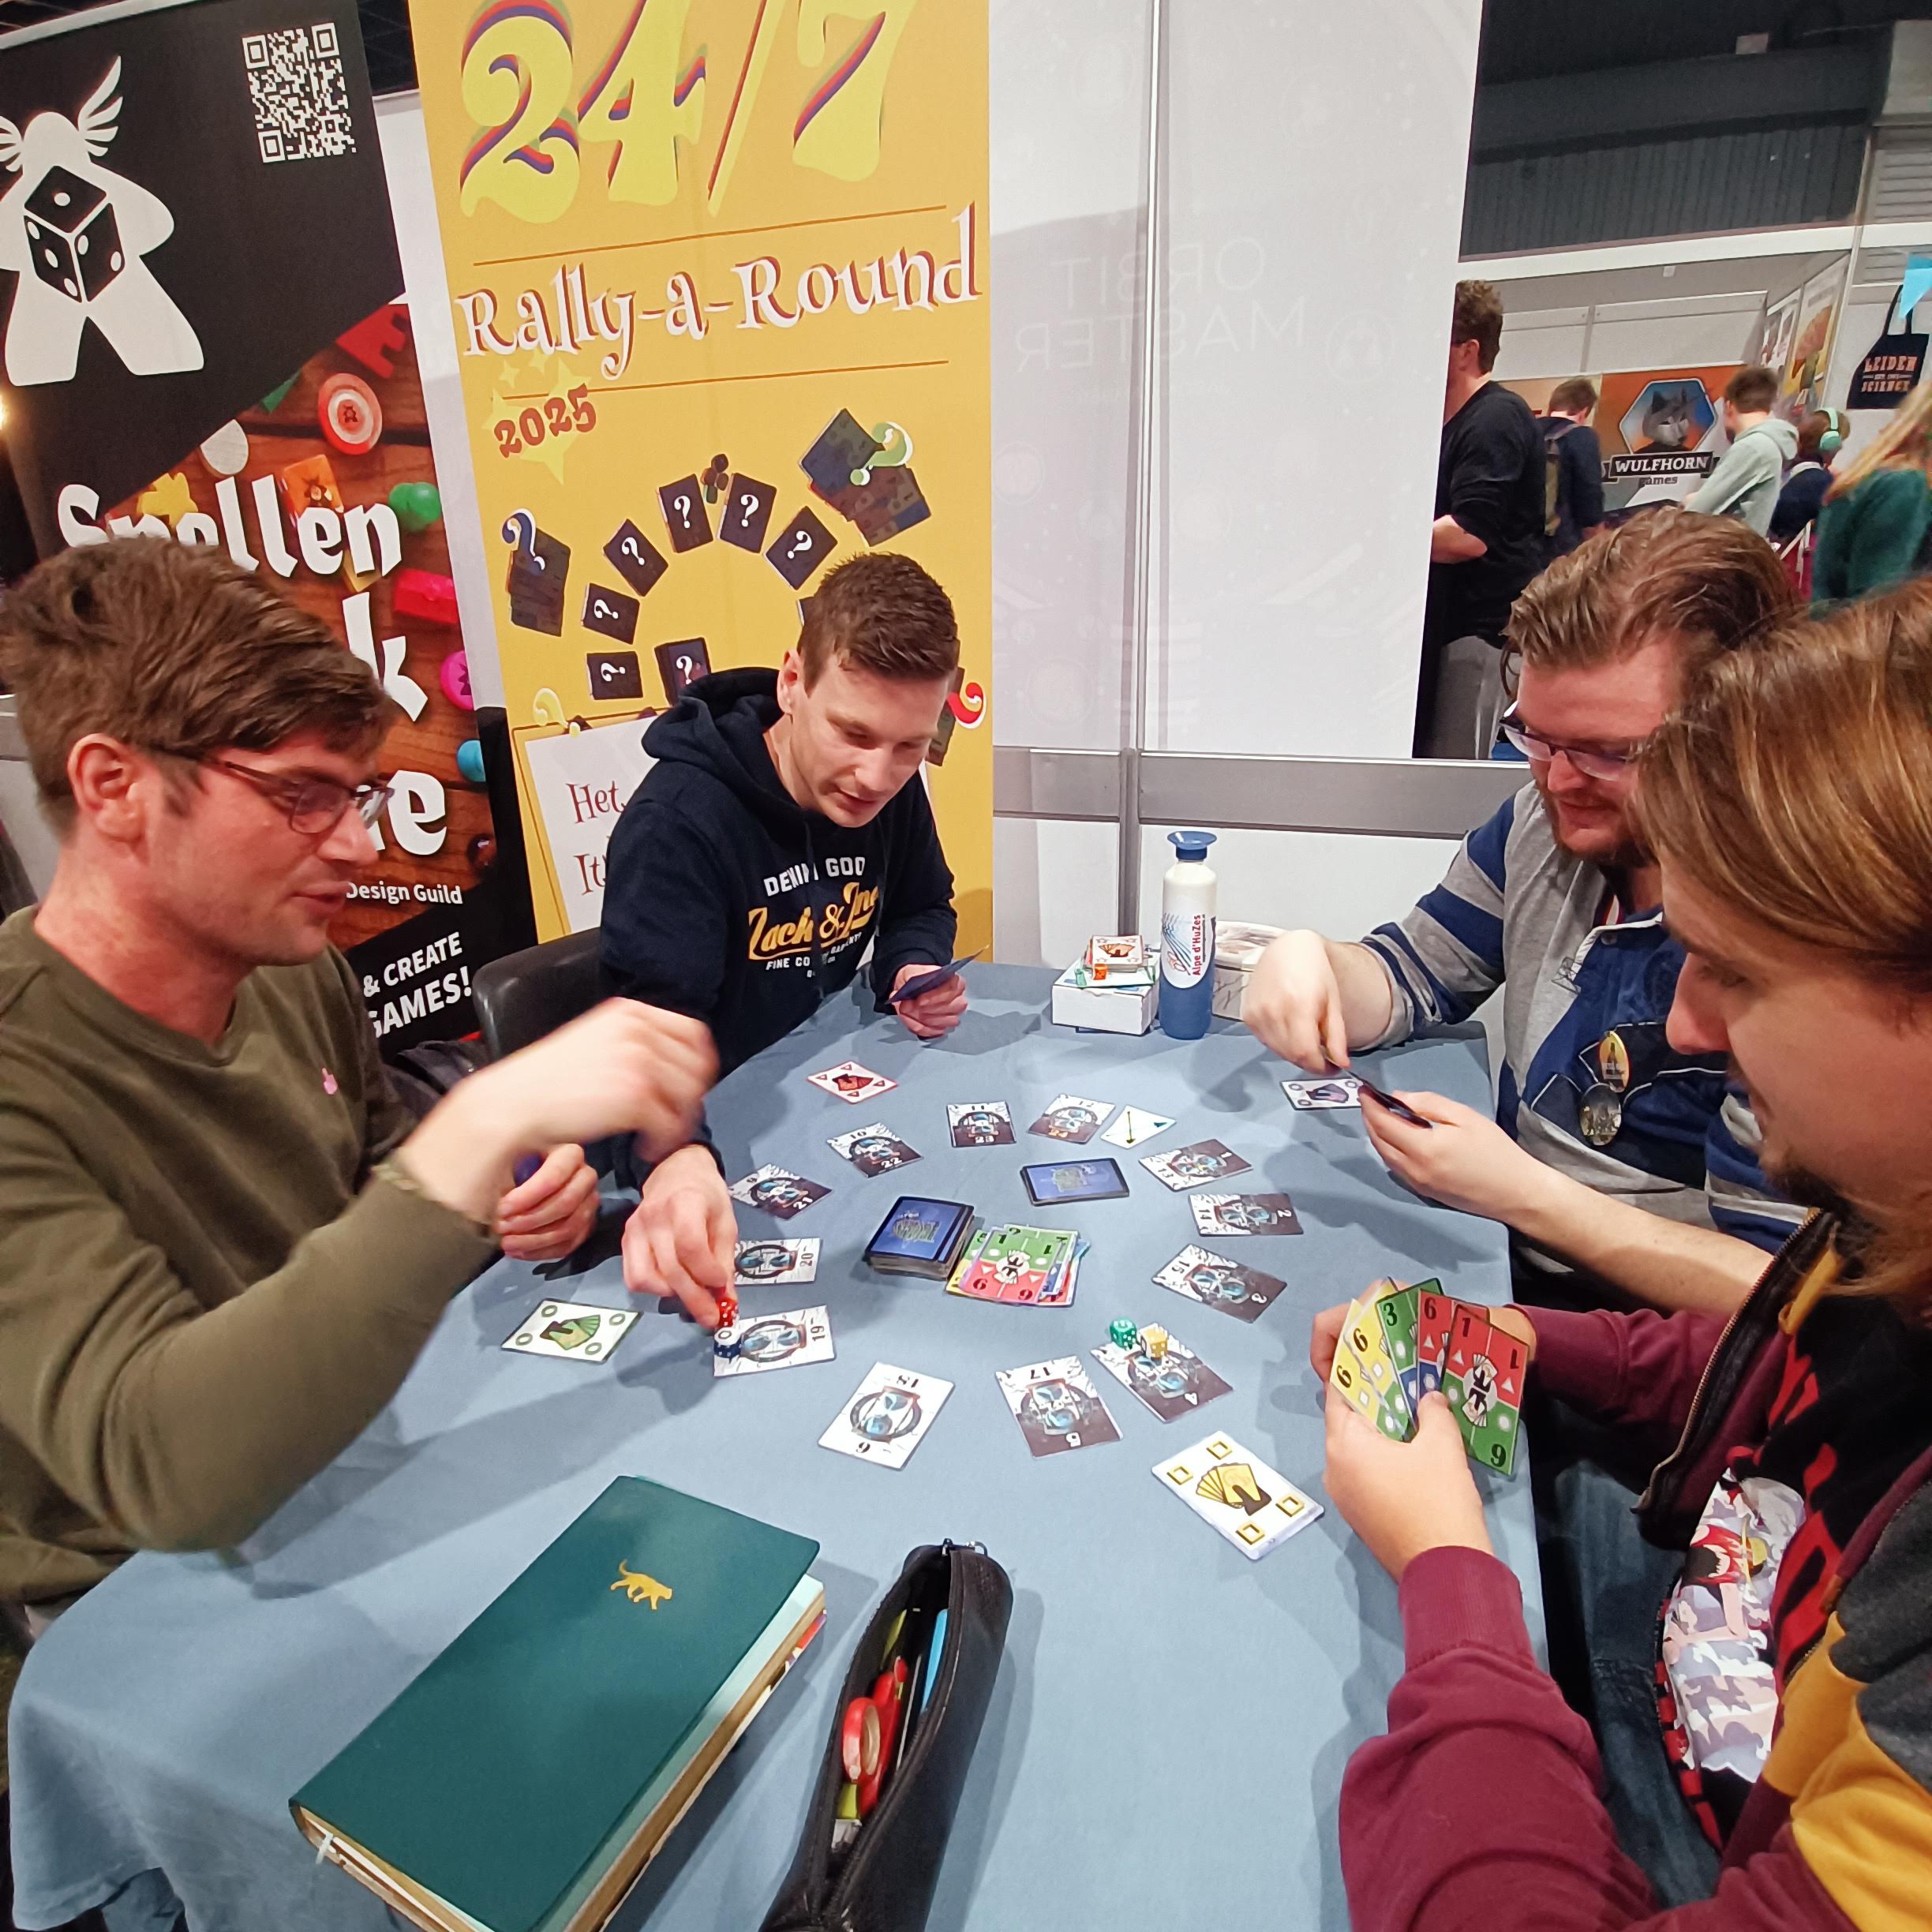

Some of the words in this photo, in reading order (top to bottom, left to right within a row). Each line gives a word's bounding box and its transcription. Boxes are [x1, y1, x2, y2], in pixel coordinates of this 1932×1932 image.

[460, 0, 919, 223] 24/7
[455, 201, 983, 380] Rally-a-Round
[494, 384, 597, 459] 2025
[1615, 457, 1709, 473] WULFHORN
[565, 780, 626, 824] Het
[413, 883, 463, 904] Guild
[1192, 915, 1201, 953] d'HuZes
[363, 975, 380, 998] &
[384, 931, 462, 987] CREATE
[766, 957, 790, 971] FINE
[1192, 956, 1203, 975] Alpe
[881, 1157, 903, 1168] 22
[793, 1197, 814, 1210] 21
[799, 1252, 814, 1267] 20
[1383, 1302, 1398, 1327] 3
[1424, 1297, 1436, 1320] 6
[1462, 1317, 1472, 1338] 1
[1353, 1327, 1368, 1352] 6
[1336, 1365, 1352, 1388] 6
